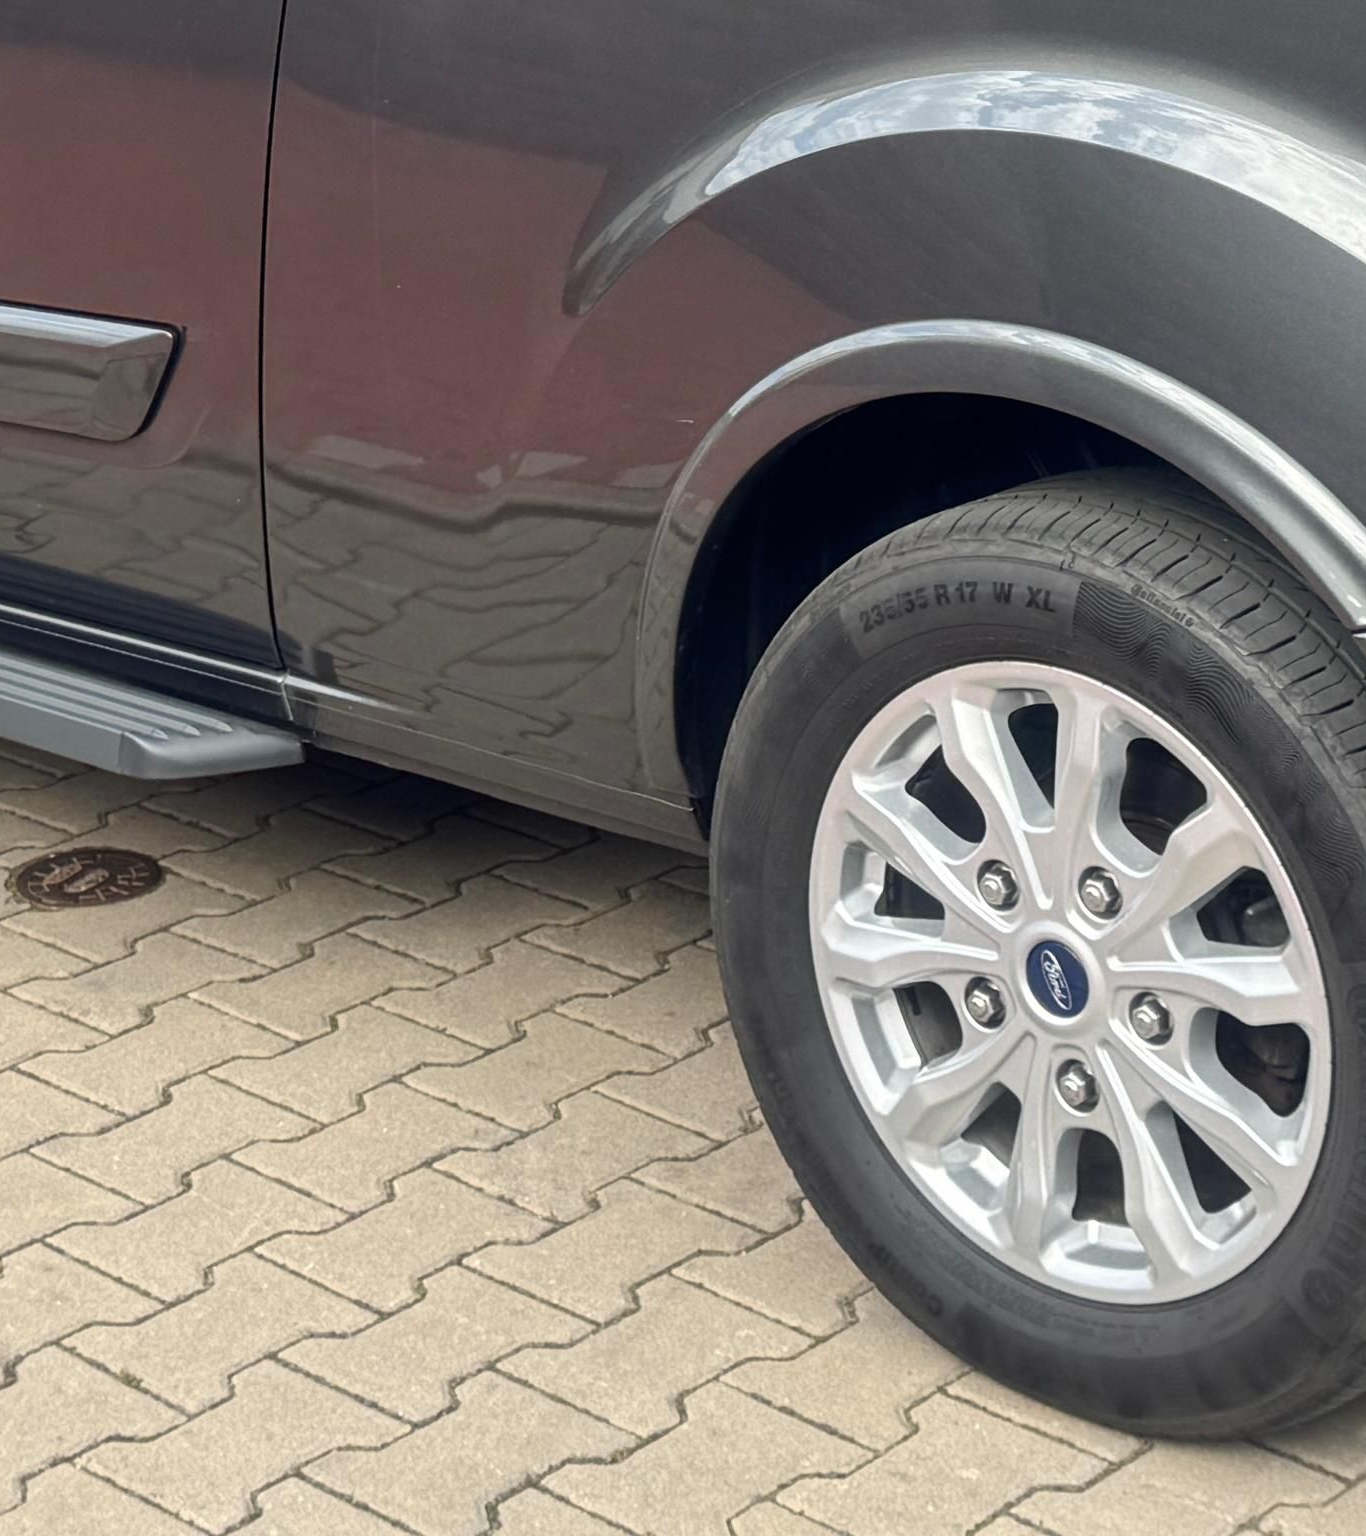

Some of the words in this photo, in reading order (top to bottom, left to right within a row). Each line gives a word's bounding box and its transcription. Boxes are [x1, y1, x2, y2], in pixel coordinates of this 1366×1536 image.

[933, 583, 951, 606] R
[955, 581, 979, 603] 17
[992, 581, 1015, 604] W
[1025, 585, 1057, 613] XL
